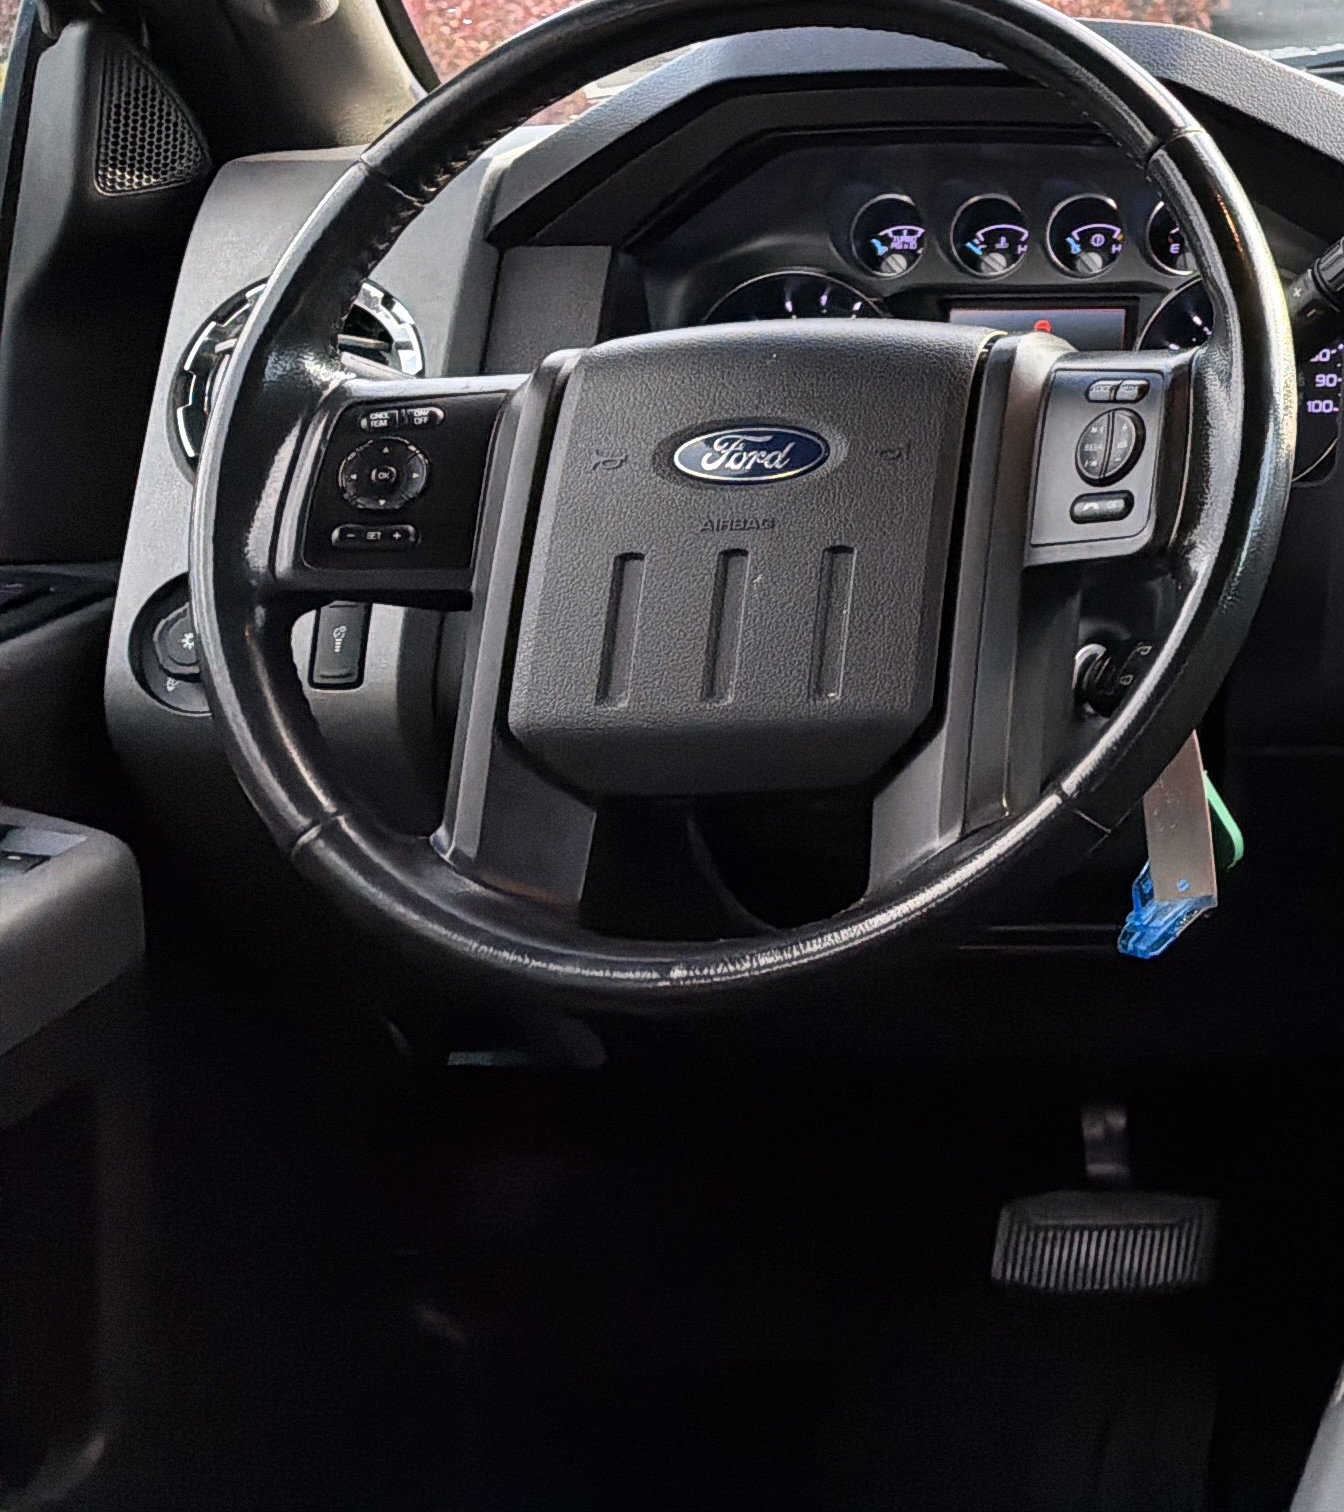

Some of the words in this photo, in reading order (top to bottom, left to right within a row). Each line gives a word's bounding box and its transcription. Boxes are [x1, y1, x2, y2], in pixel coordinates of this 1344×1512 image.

[1169, 244, 1180, 254] E
[1315, 373, 1337, 387] 90
[1306, 400, 1334, 413] 100
[701, 434, 796, 471] Ford
[378, 471, 390, 479] OK
[701, 518, 776, 532] AIRBAG
